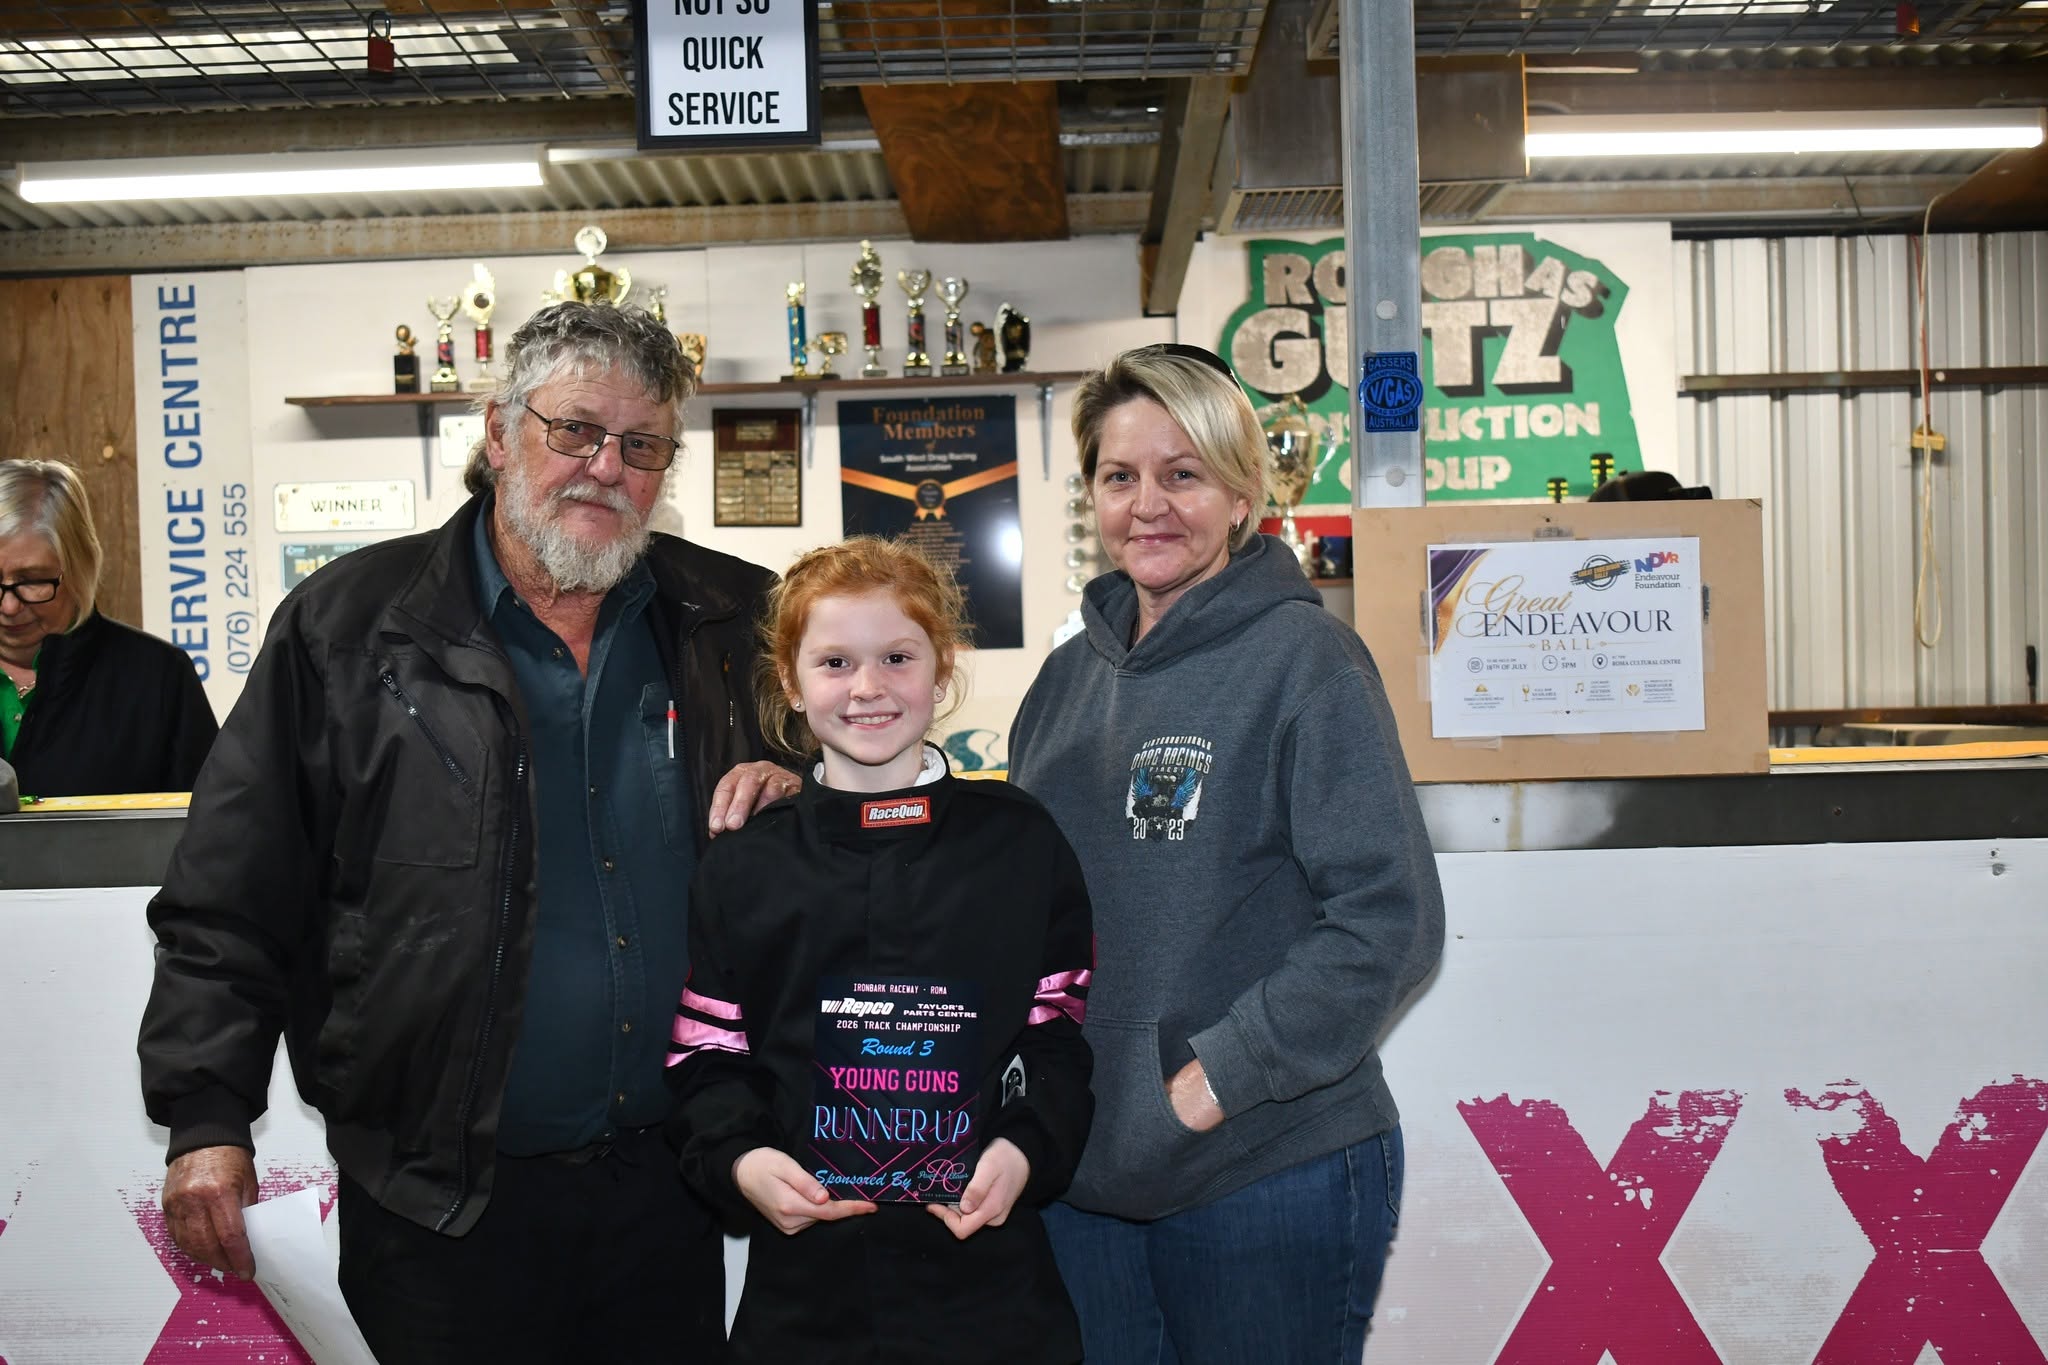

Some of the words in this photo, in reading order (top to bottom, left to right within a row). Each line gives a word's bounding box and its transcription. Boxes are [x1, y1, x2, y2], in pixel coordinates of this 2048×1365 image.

[683, 36, 764, 72] QUICK
[668, 91, 780, 126] SERVICE
[1263, 244, 1525, 306] ROGH
[1367, 357, 1413, 371] GASSERS
[157, 285, 203, 469] CENTRE
[872, 404, 985, 425] Foundation
[1368, 415, 1415, 428] AUSTRALIA
[884, 421, 976, 440] Members
[223, 483, 248, 536] 555
[310, 498, 384, 513] WINNER
[224, 547, 249, 598] 224
[1635, 574, 1680, 582] Endeavour
[1635, 582, 1681, 590] Foundation
[1460, 575, 1574, 626] Great
[1483, 609, 1674, 637] ENDEAVOUR
[226, 611, 256, 674] (076)
[1541, 638, 1594, 651] BALL
[1130, 747, 1162, 771] DRAG
[869, 804, 924, 821] RaceQuip
[1133, 818, 1146, 840] 20
[1168, 818, 1185, 840] 23
[854, 983, 886, 993] IRONBARK
[889, 984, 919, 994] RACEWAY
[930, 985, 947, 995] ROMA
[839, 997, 895, 1018] Repco
[917, 1003, 965, 1011] TAYLOR'S
[937, 1010, 977, 1018] CENTRE
[836, 1020, 859, 1029] 2026
[864, 1021, 890, 1030] TRACK
[895, 1022, 961, 1032] CHAMPIONSHIP
[861, 1038, 916, 1056] Round
[919, 1040, 935, 1056] 3
[830, 1067, 899, 1091] YOUNG
[905, 1070, 960, 1093] GUNS
[814, 1105, 928, 1143] RUNNER
[935, 1108, 970, 1143] UP
[815, 1169, 888, 1187] Sponsored
[891, 1171, 913, 1190] By
